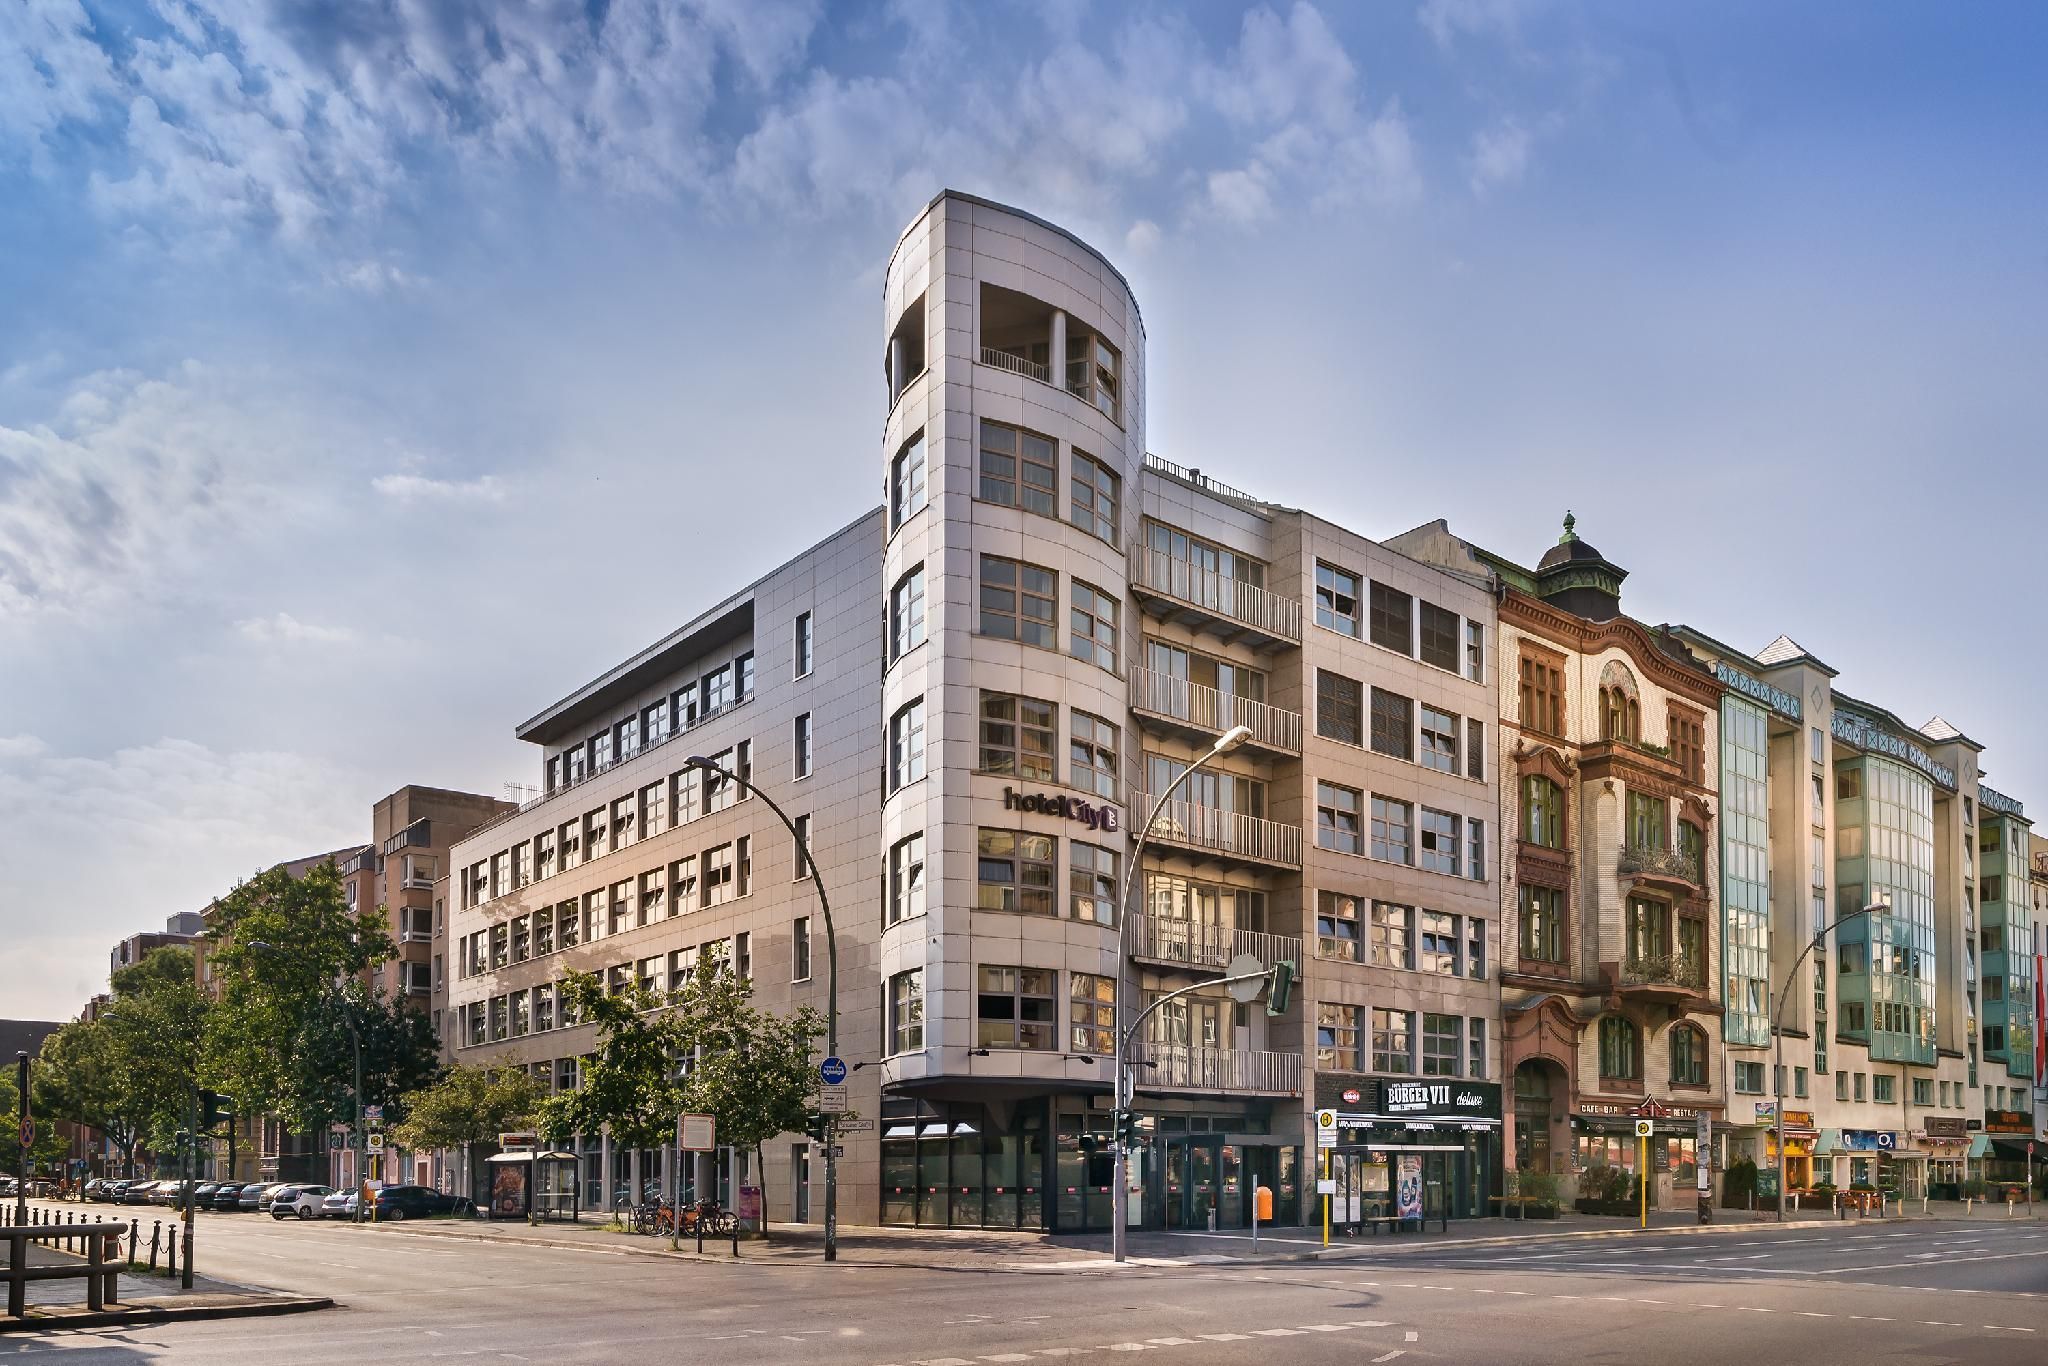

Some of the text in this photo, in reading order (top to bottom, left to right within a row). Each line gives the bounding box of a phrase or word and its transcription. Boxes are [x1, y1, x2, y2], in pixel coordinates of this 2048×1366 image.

[1387, 1085, 1450, 1105] BURGER VII
[1456, 1091, 1483, 1106] deluxe
[1581, 1104, 1599, 1113] CAFE
[1603, 1105, 1618, 1114] BAR
